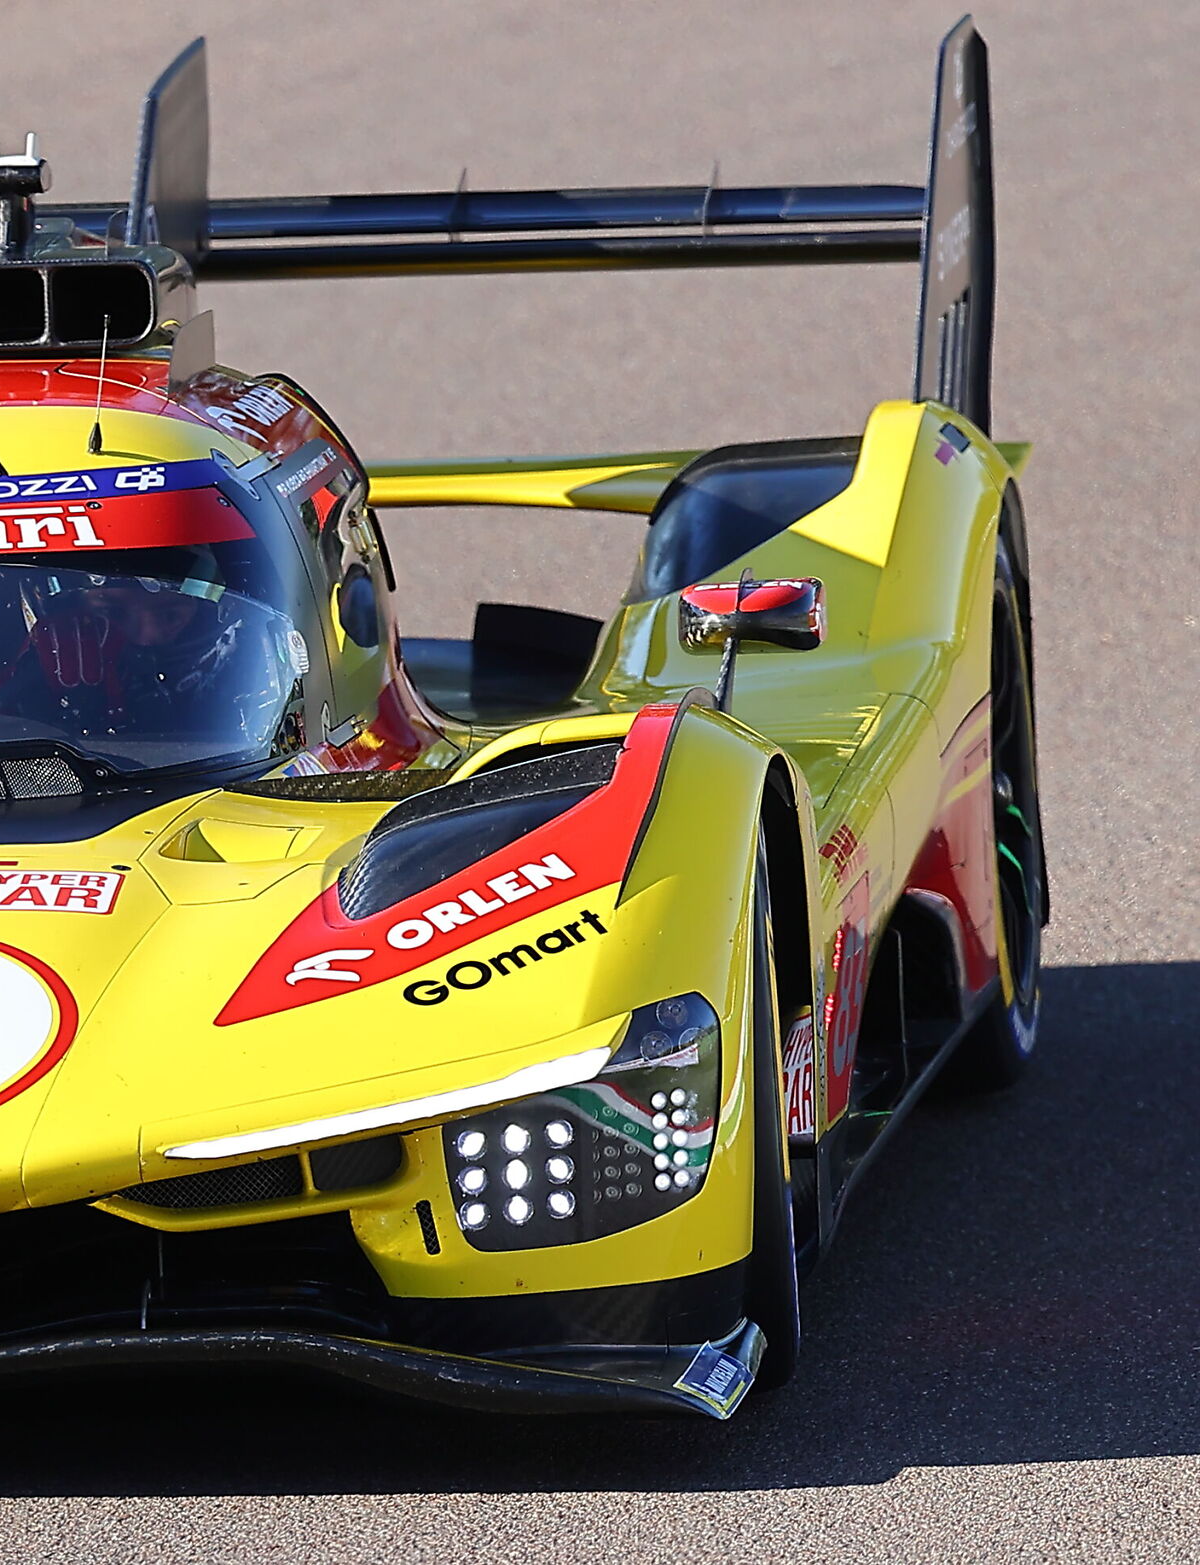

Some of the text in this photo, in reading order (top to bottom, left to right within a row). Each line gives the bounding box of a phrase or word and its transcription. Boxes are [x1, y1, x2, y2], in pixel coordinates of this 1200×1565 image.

[386, 853, 577, 950] ORLEN
[402, 909, 609, 1006] GOmart
[784, 1063, 814, 1135] AR
